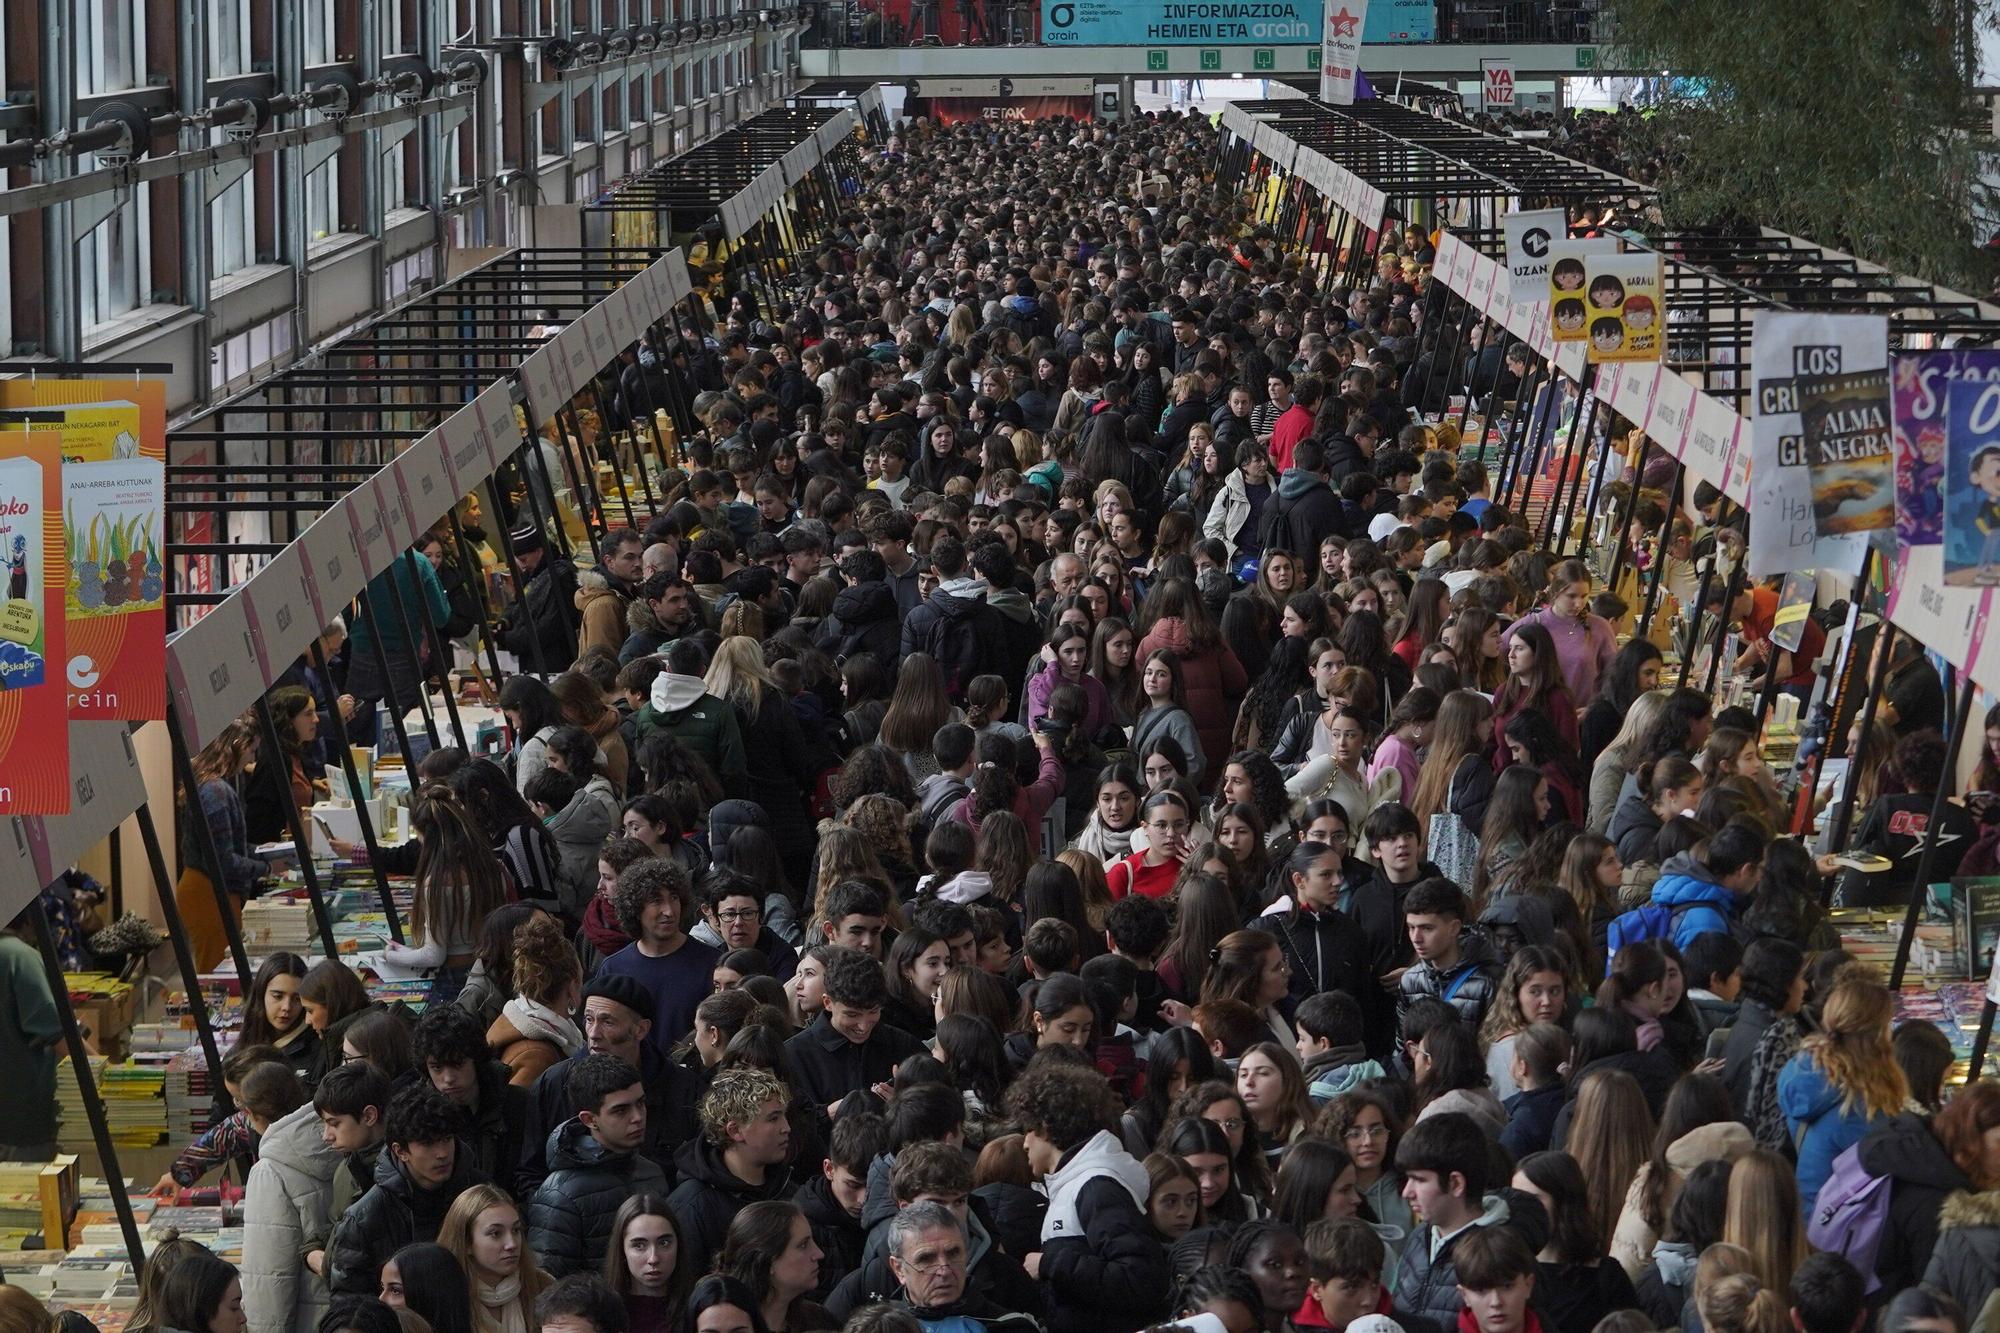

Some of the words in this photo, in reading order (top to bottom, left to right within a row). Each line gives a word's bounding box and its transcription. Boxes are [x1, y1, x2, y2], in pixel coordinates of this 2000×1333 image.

[1163, 4, 1300, 20] INFORMAZIOA,
[1048, 31, 1079, 41] orain
[1148, 24, 1212, 38] HEMEN
[1217, 24, 1248, 38] ETA
[1252, 20, 1309, 38] orain
[1487, 69, 1513, 86] YA
[1486, 87, 1513, 103] NIZ
[982, 107, 1025, 119] ZETAK
[1514, 263, 1550, 277] UZAN
[1796, 348, 1840, 376] LOS
[51, 423, 70, 431] EGUN
[71, 421, 108, 430] NEKAGARRI
[1823, 406, 1884, 436] ALMA
[1819, 432, 1893, 464] NEGRA
[70, 481, 116, 490] ANAI-ARREBA
[116, 478, 153, 487] KUTTUNAK
